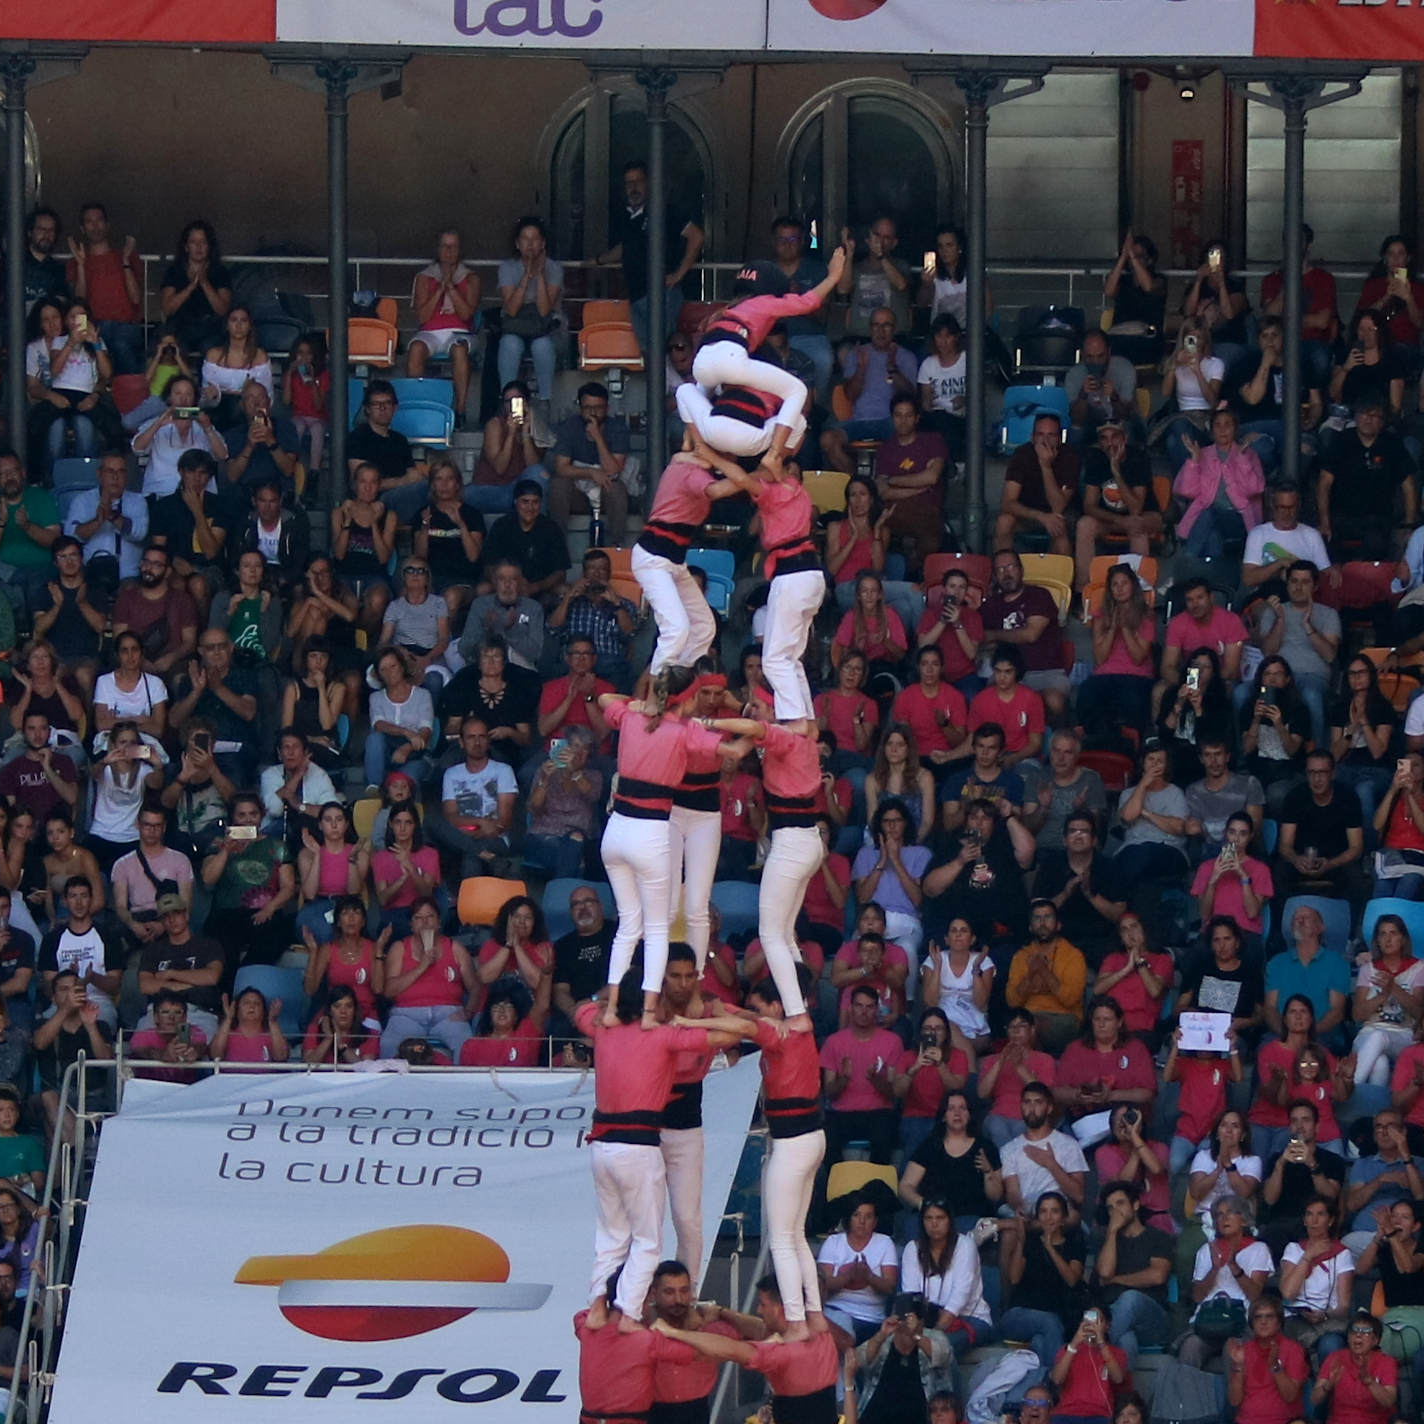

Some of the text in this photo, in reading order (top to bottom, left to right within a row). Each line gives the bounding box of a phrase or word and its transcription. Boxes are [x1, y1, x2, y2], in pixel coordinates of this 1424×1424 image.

[237, 1098, 587, 1125] Donem supo
[227, 1122, 257, 1142] a
[279, 1122, 326, 1144] la
[348, 1123, 555, 1149] tradició
[218, 1152, 483, 1187] la cultura
[155, 1361, 568, 1403] REPSOL
